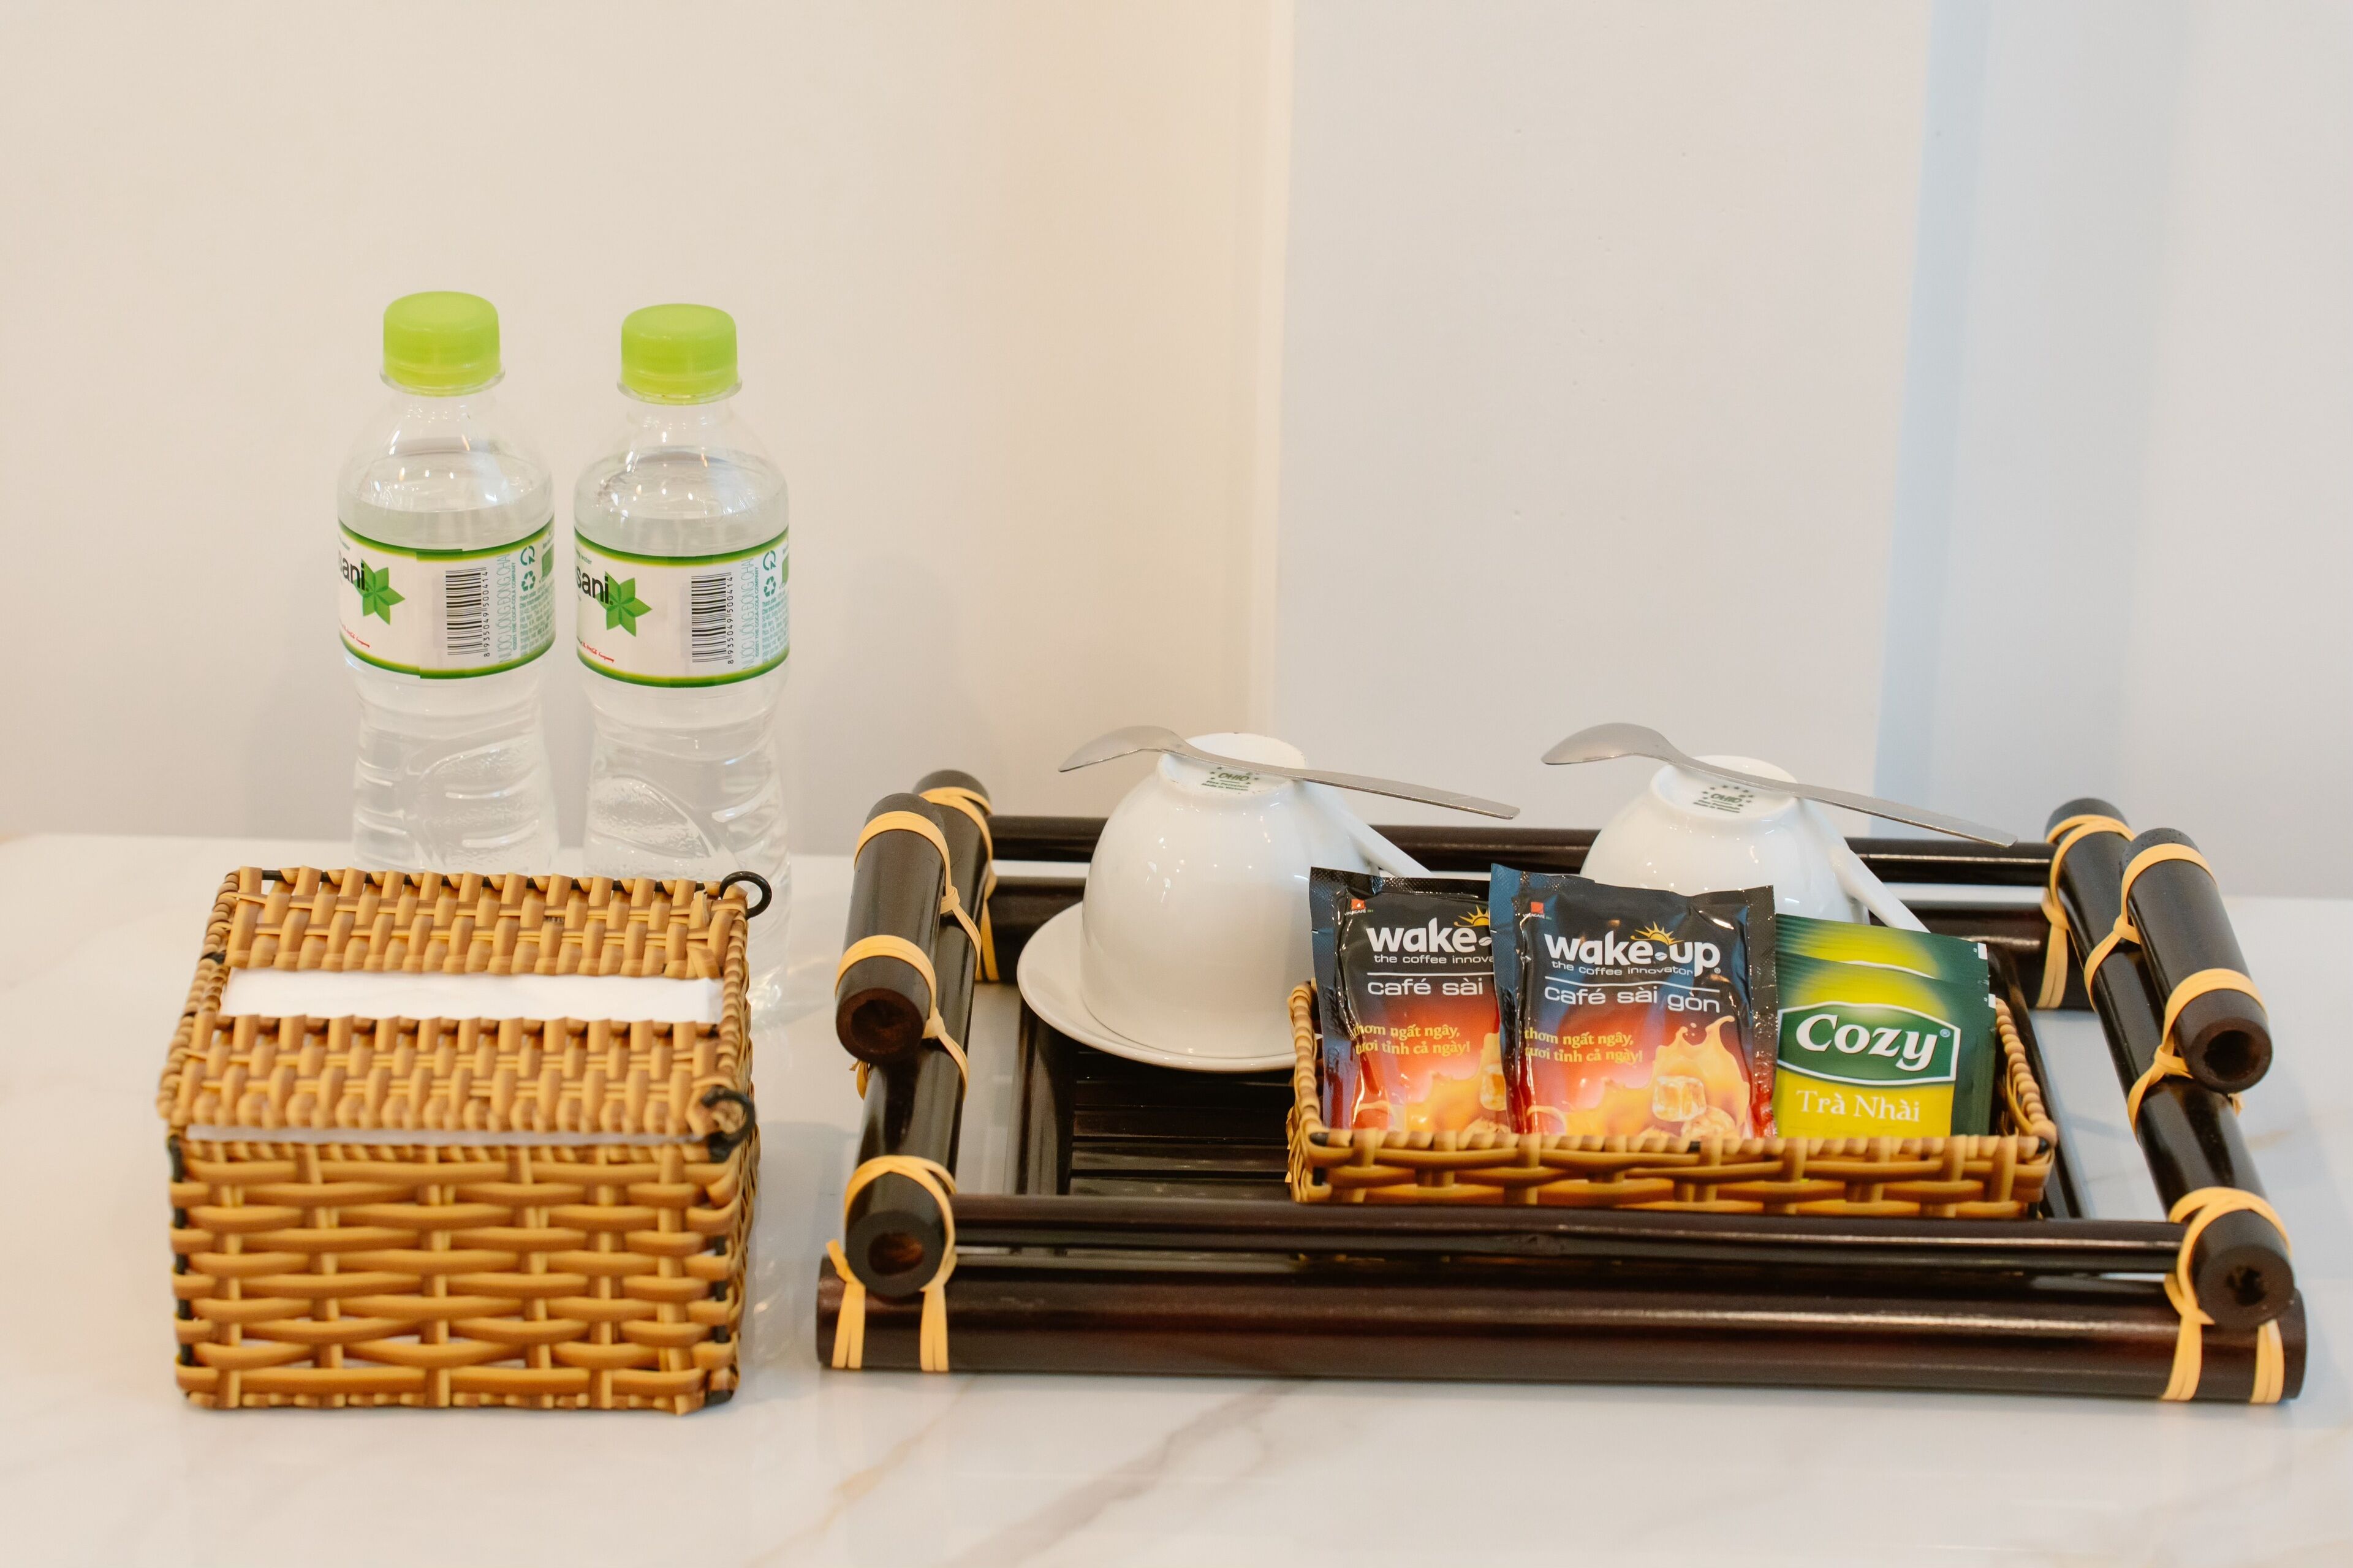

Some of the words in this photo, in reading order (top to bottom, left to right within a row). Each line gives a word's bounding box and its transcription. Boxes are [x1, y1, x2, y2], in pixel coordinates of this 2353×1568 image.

[1374, 954, 1398, 963] the
[1403, 954, 1447, 964] coffee
[1552, 961, 1574, 971] the
[1578, 966, 1623, 975] coffee
[1627, 966, 1693, 976] innovator
[1367, 977, 1431, 996] café
[1442, 978, 1483, 996] sài
[1544, 986, 1606, 1006] café
[1616, 987, 1658, 1004] sài
[1667, 992, 1720, 1013] gòn
[1524, 1026, 1558, 1045] thơm
[1795, 1013, 1938, 1072] Cozy
[1413, 1041, 1428, 1054] cả
[1433, 1040, 1471, 1057] ngày!
[1586, 1048, 1602, 1062] cả
[1605, 1048, 1643, 1066] ngày!
[1795, 1090, 1846, 1115] Trà
[1853, 1095, 1920, 1123] Nhài
